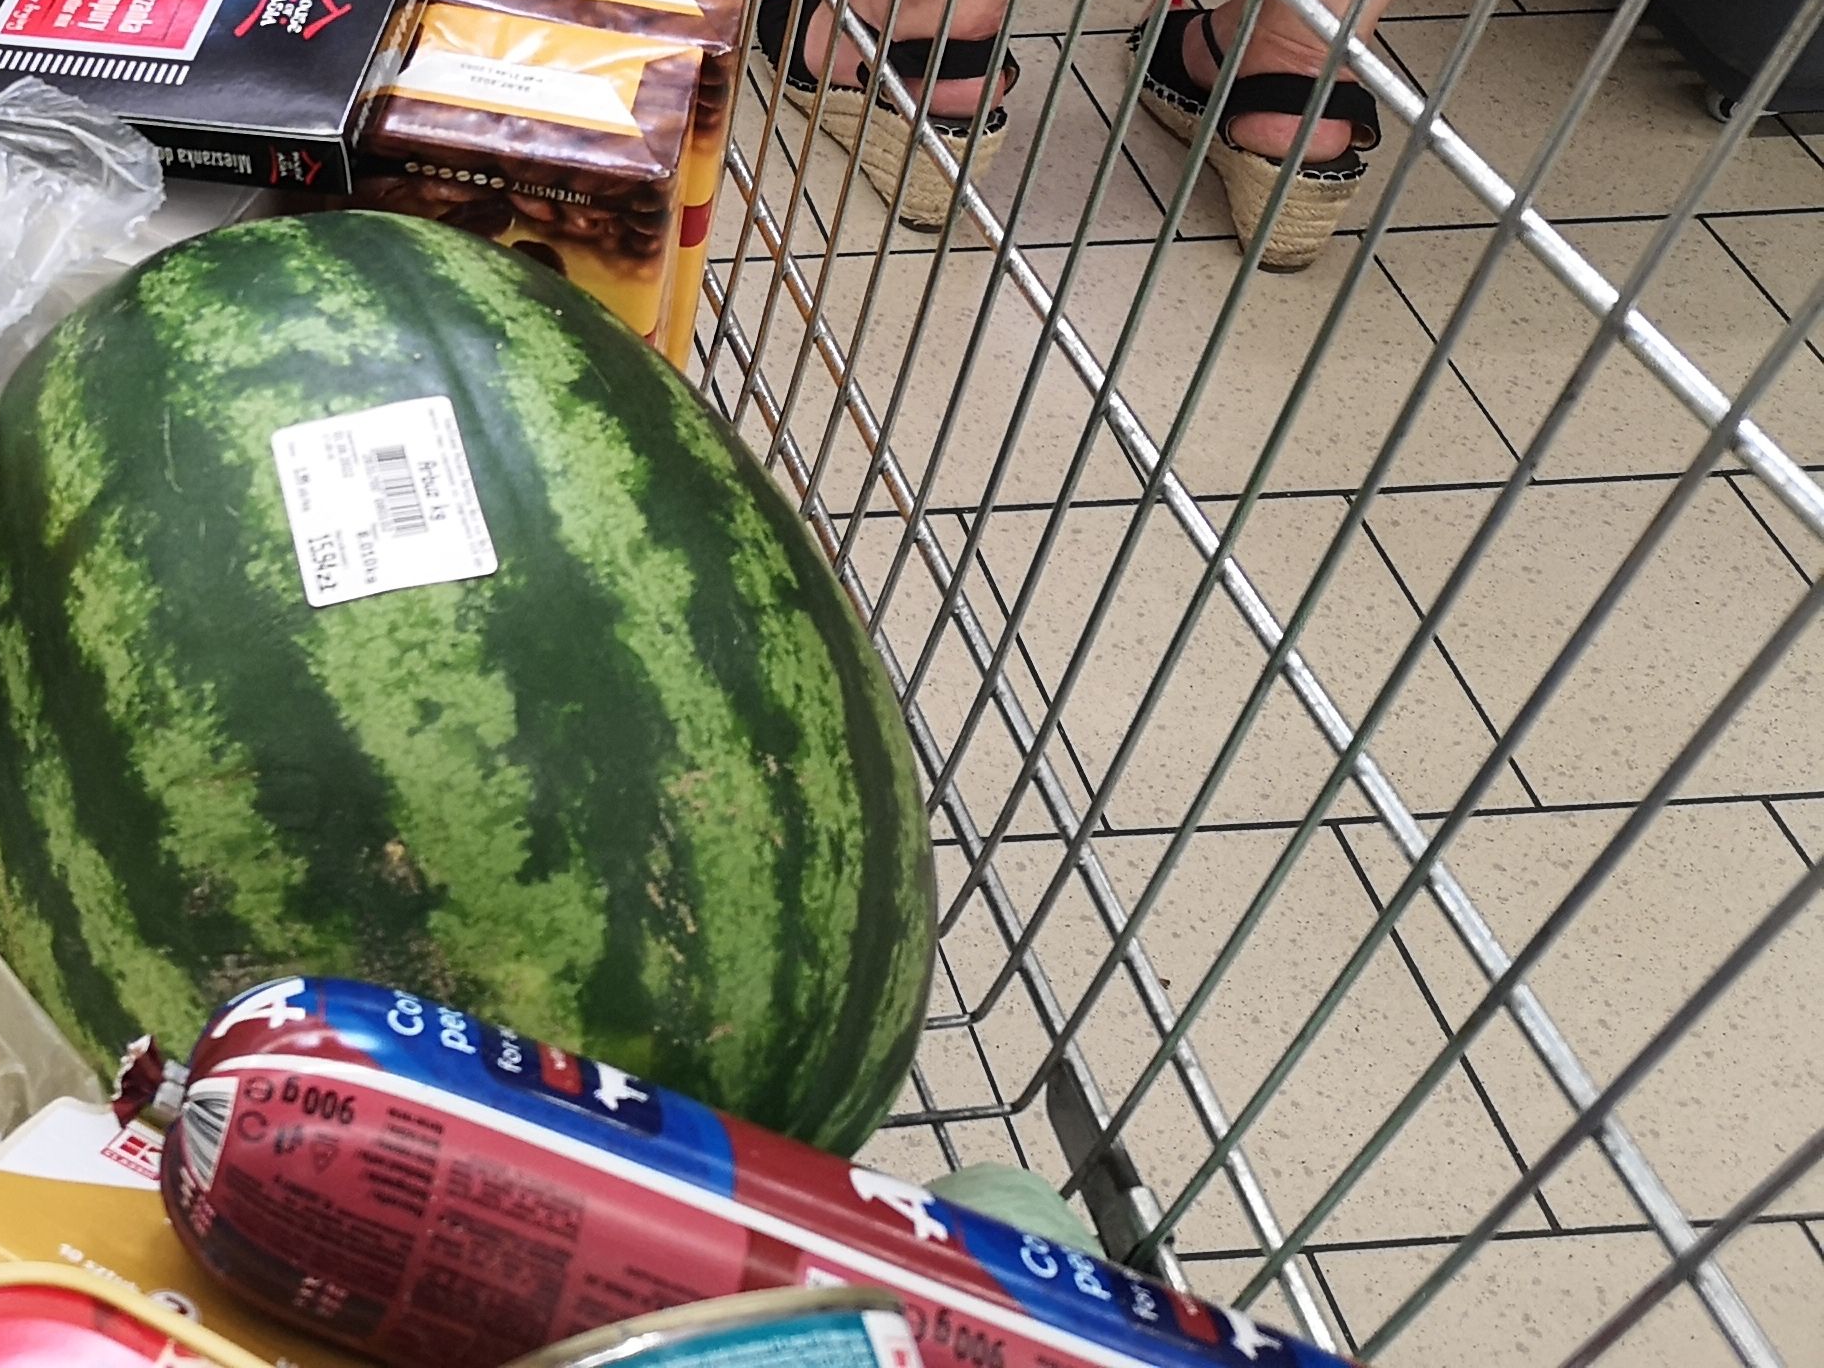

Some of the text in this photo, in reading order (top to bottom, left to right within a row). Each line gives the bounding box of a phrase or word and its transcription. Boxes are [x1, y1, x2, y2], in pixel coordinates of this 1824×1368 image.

[176, 147, 252, 174] Mieszanka
[512, 181, 592, 206] INTENSITY
[417, 460, 449, 521] Arbuz kg
